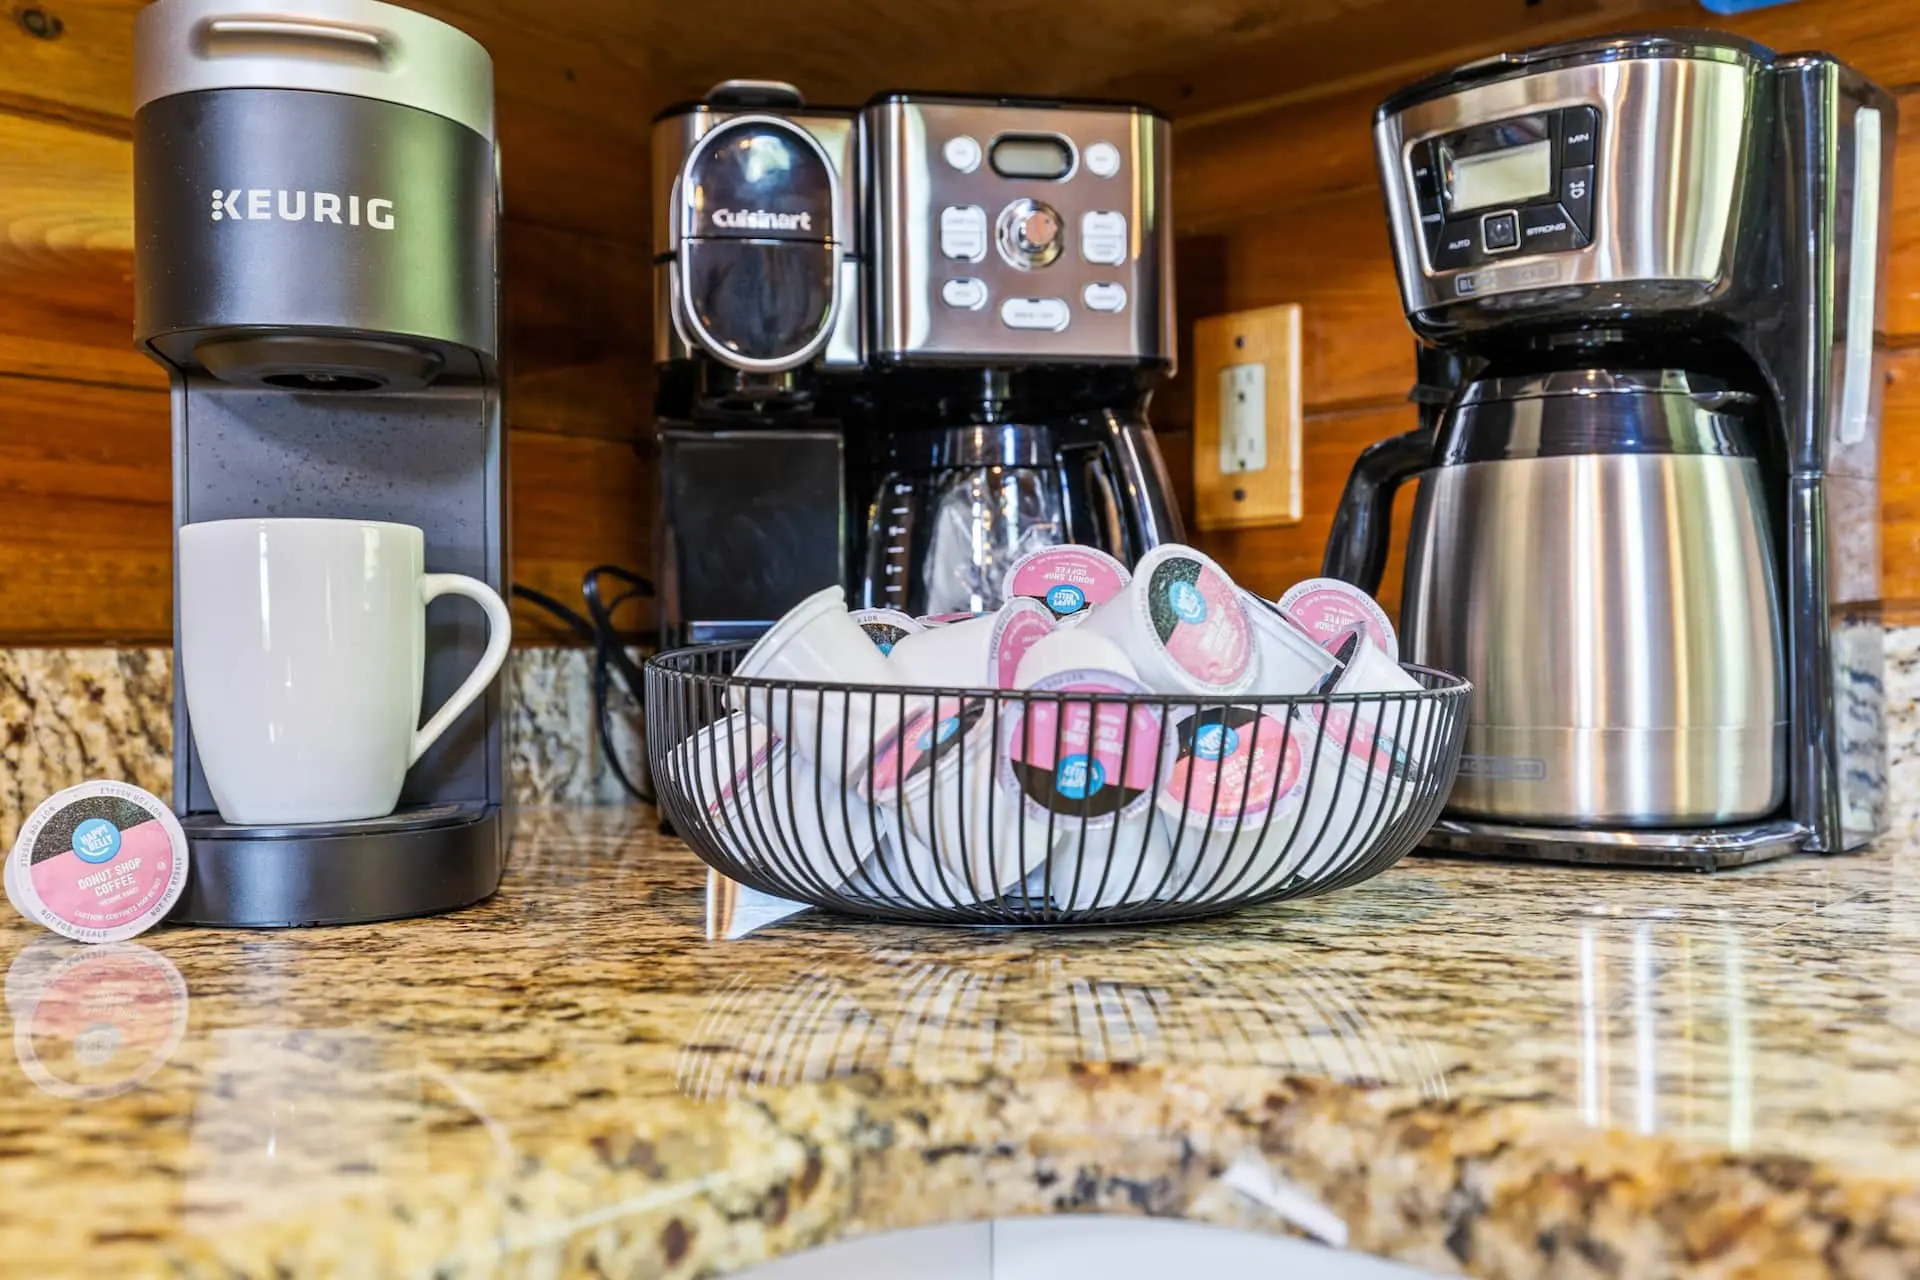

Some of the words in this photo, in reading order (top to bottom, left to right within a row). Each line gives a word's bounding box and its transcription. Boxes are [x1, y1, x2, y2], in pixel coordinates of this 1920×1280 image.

[1567, 133, 1590, 145] MIN
[211, 189, 395, 230] KEURIG
[711, 208, 812, 231] Cuisinart
[1525, 222, 1567, 236] STRONG
[1448, 239, 1471, 251] AUTO
[79, 823, 109, 847] HAPPY
[87, 834, 113, 852] BELLY
[77, 868, 112, 890] DONUT
[114, 856, 142, 876] SHOP
[94, 872, 136, 897] COFFEE
